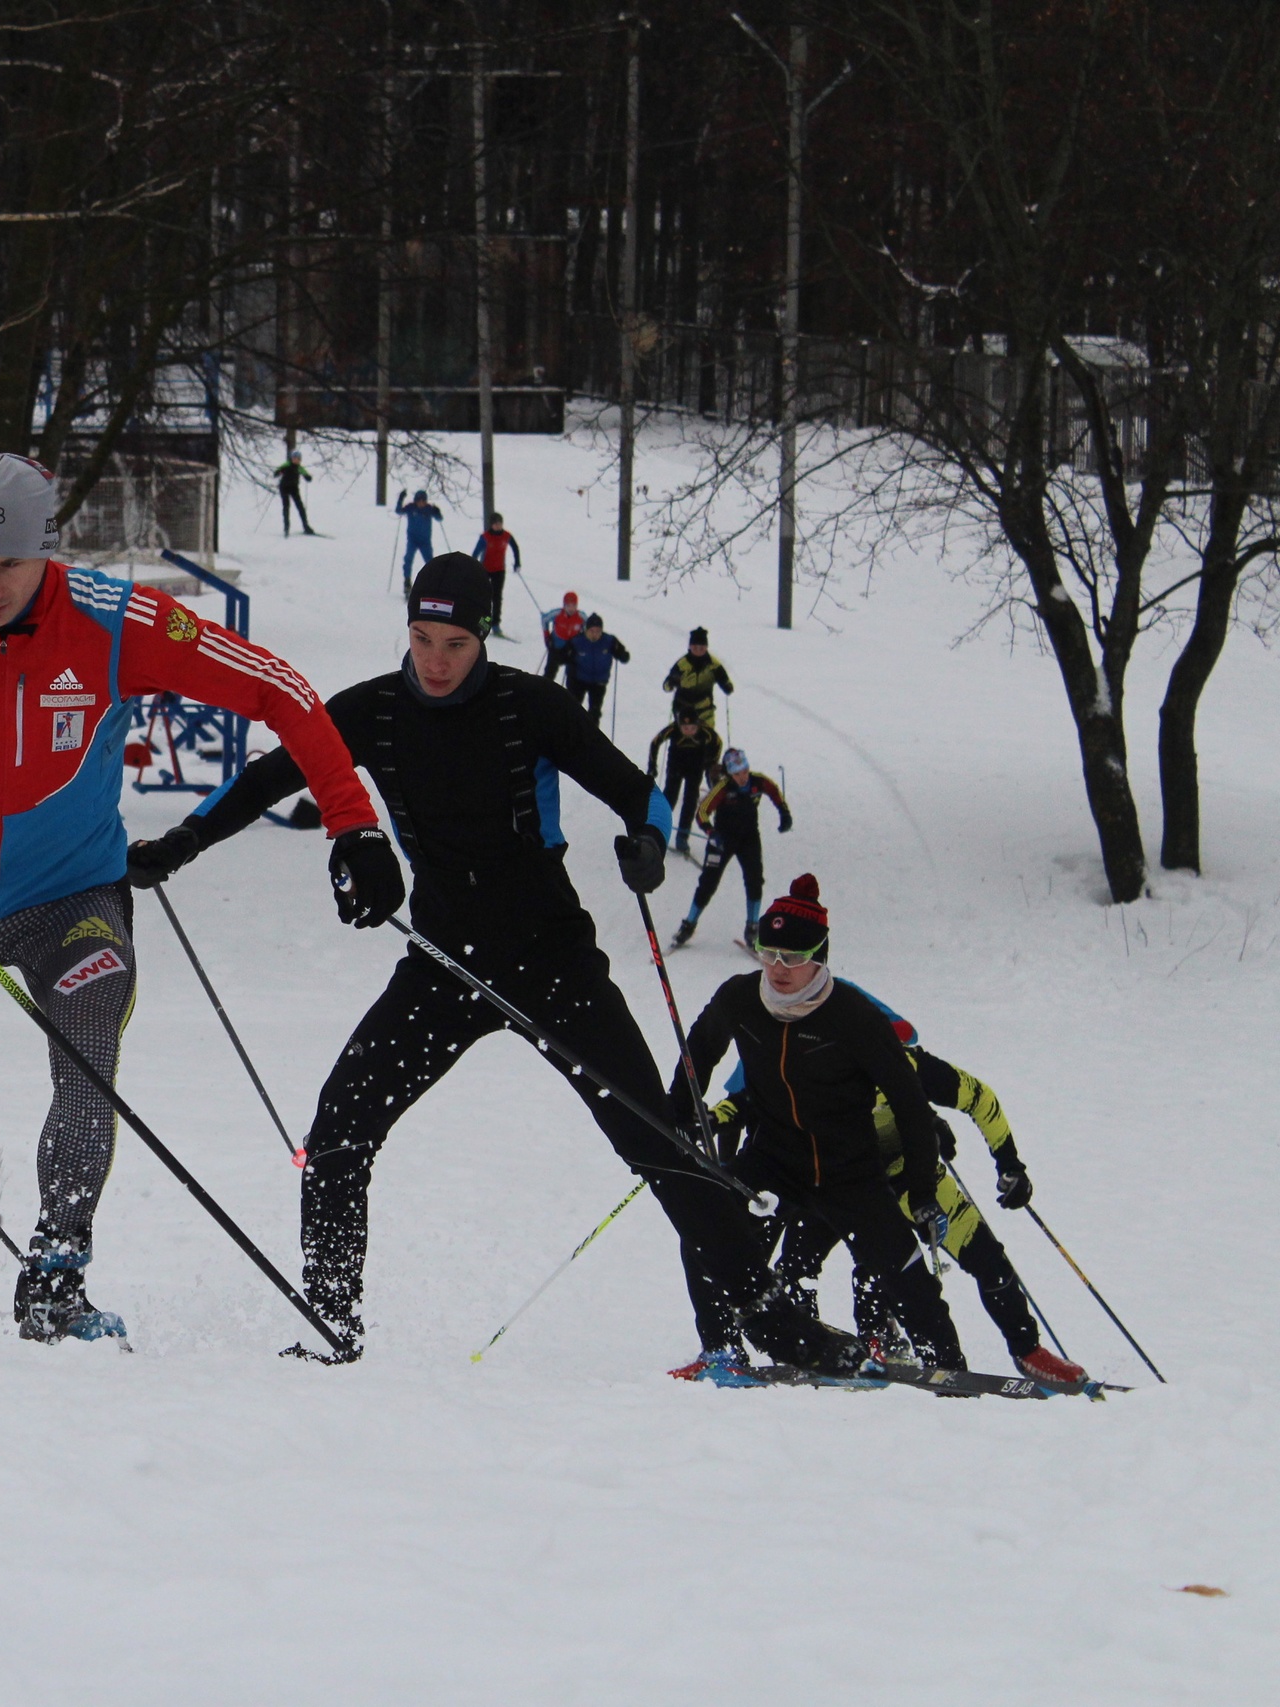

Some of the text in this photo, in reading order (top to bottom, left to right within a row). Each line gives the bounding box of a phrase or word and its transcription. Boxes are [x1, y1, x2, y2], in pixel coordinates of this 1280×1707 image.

[49, 682, 84, 691] adidas
[51, 695, 95, 704] СОГЛАСИЕ
[55, 743, 78, 751] RBU
[360, 830, 384, 839] SWIX
[61, 927, 124, 948] adidas
[409, 932, 455, 968] SWIX
[60, 951, 120, 988] twd
